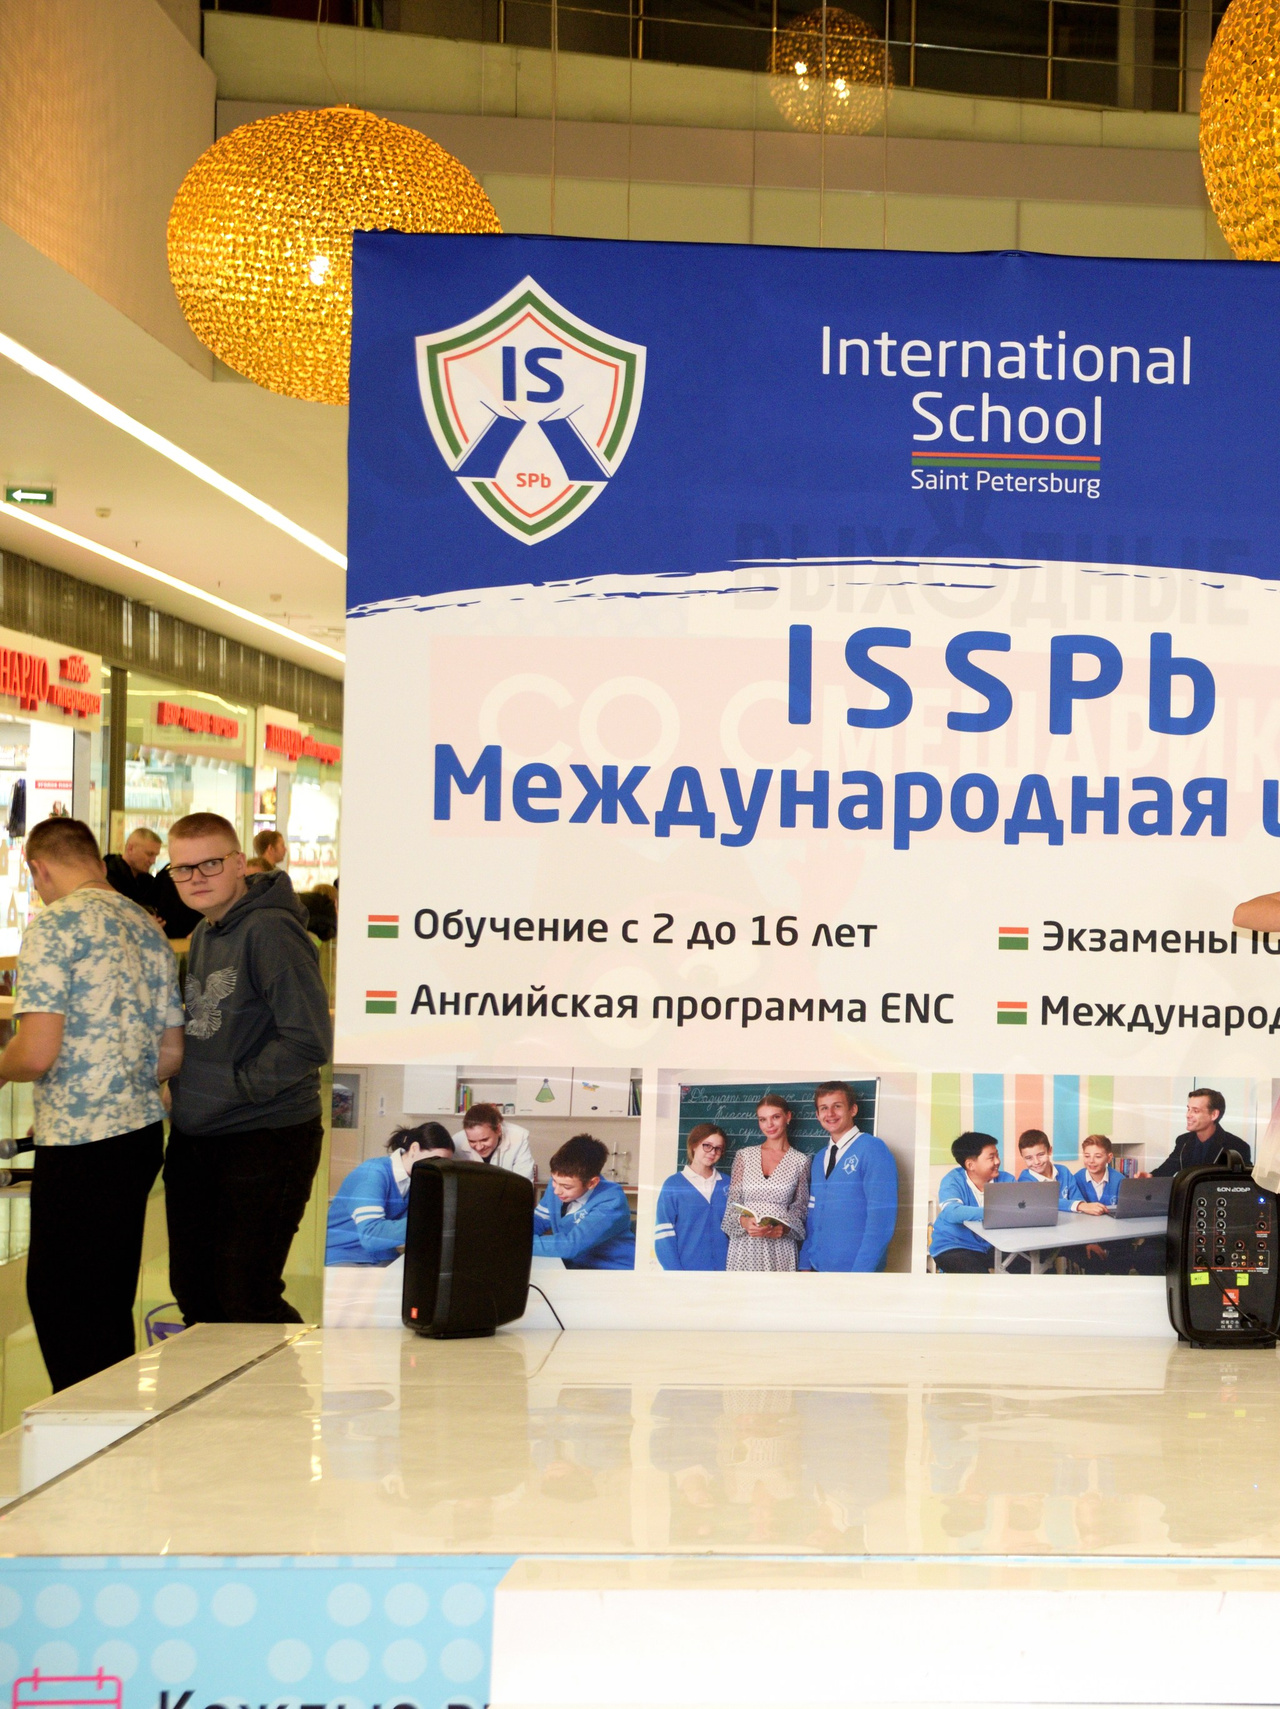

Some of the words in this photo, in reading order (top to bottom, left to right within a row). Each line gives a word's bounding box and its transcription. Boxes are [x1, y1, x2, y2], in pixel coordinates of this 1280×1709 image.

[502, 346, 564, 403] IS
[822, 325, 1191, 385] International
[912, 391, 1102, 446] School
[516, 472, 552, 489] SPb
[911, 469, 968, 491] Saint
[976, 470, 1101, 499] Petersburg
[788, 624, 1216, 736] ISSPb
[434, 744, 1228, 850] Международная
[414, 908, 608, 948] Обучение
[621, 919, 639, 944] с
[653, 913, 674, 944] 2
[686, 921, 736, 950] до
[751, 915, 798, 946] 16
[811, 923, 878, 948] лет
[1042, 920, 1238, 954] Экзамены
[410, 984, 638, 1019] Английская
[652, 995, 866, 1028] программа
[881, 992, 954, 1024] ENC
